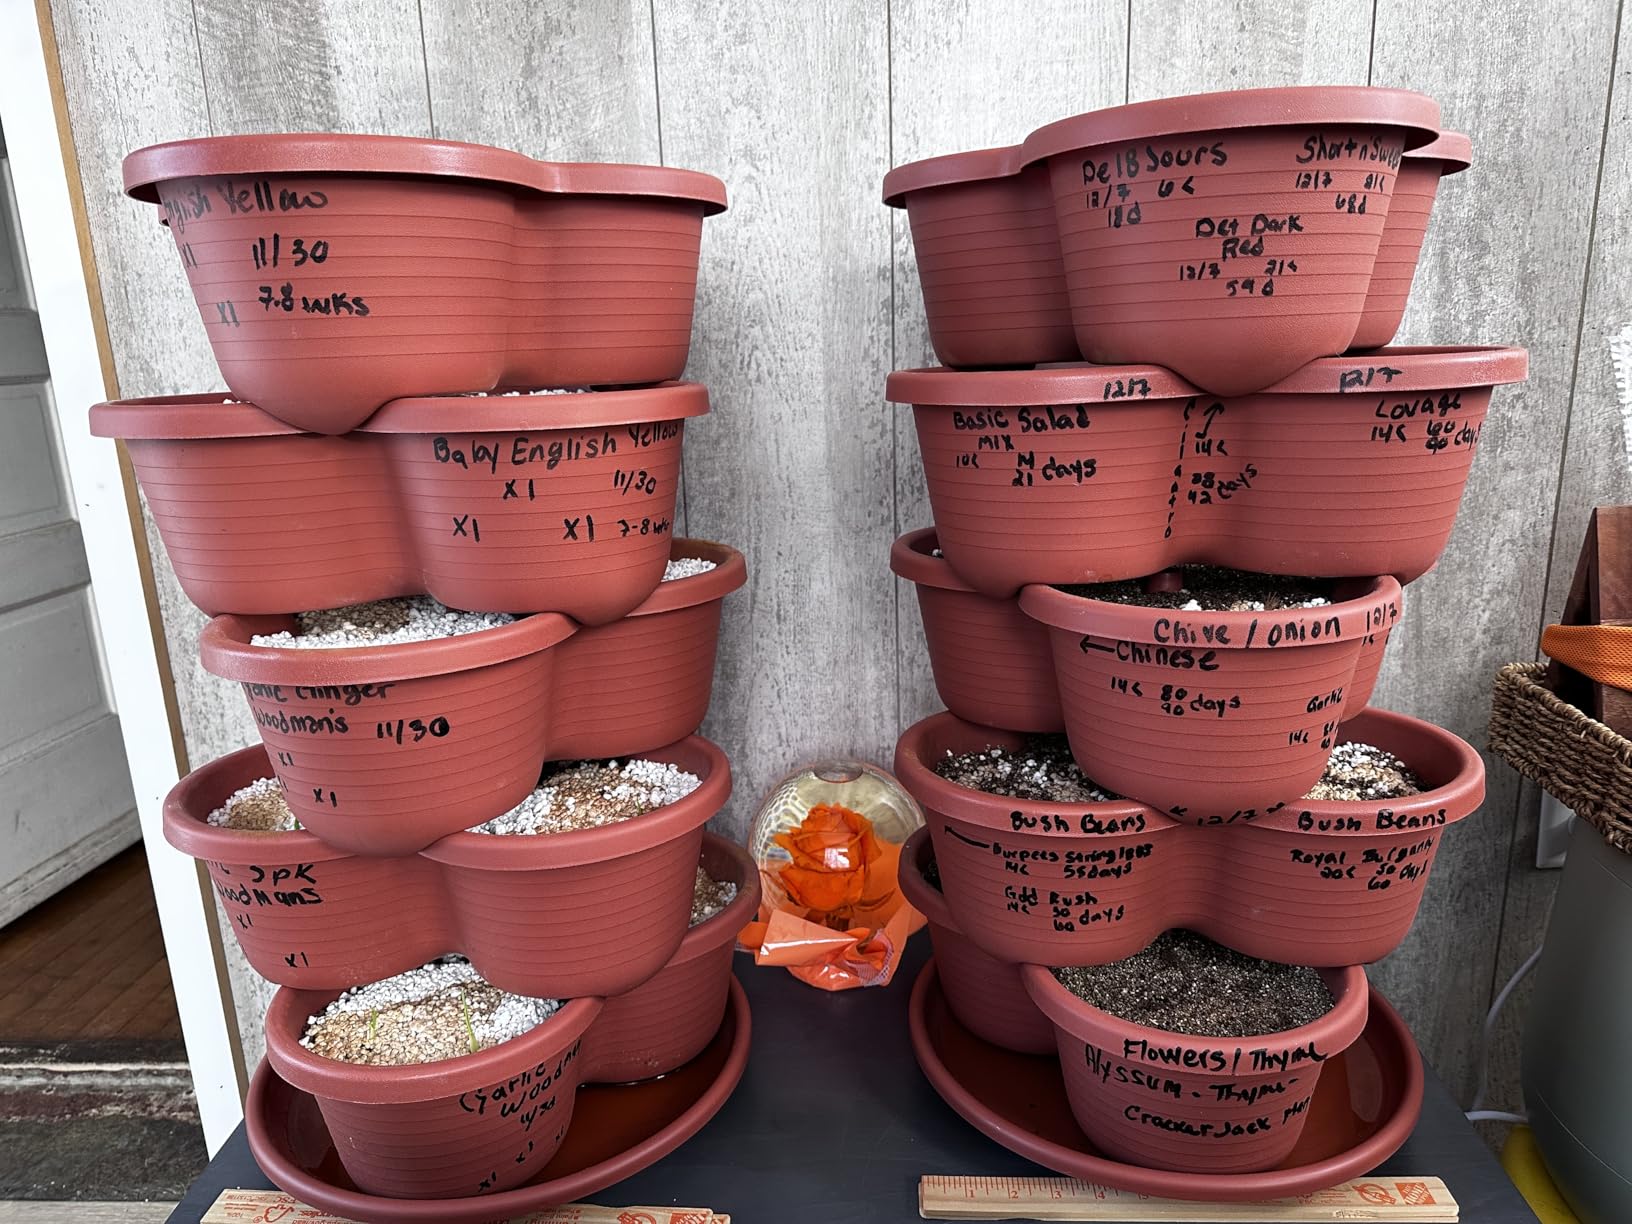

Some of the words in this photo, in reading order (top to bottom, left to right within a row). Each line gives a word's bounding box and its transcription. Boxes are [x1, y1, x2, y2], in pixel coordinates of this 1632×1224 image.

[216, 180, 328, 214] Yellow
[1251, 213, 1304, 236] Dark
[252, 233, 329, 269] 11/30
[1222, 235, 1264, 261] Red
[953, 408, 1009, 430] Basic
[1018, 405, 1090, 433] Salad
[433, 437, 498, 473] Baby
[511, 431, 616, 470] English
[628, 423, 678, 448] Yellow
[614, 469, 656, 495] 11/30
[1042, 457, 1097, 483] days
[1154, 618, 1231, 645] Chive
[1117, 641, 1220, 671] Chinese
[1190, 694, 1241, 718] days
[377, 716, 450, 744] 11/30
[1010, 811, 1070, 832] Bush
[1080, 814, 1146, 834] Beans
[1297, 811, 1362, 831] Bush
[1375, 808, 1447, 830] Beans
[1291, 850, 1346, 868] Royal
[1050, 891, 1098, 906] Rush
[1079, 905, 1125, 925] days
[1124, 1039, 1226, 1071] Flowers
[1010, 1190, 1019, 1199] 2
[1054, 1190, 1062, 1199] 3
[1098, 1190, 1106, 1200] 4
